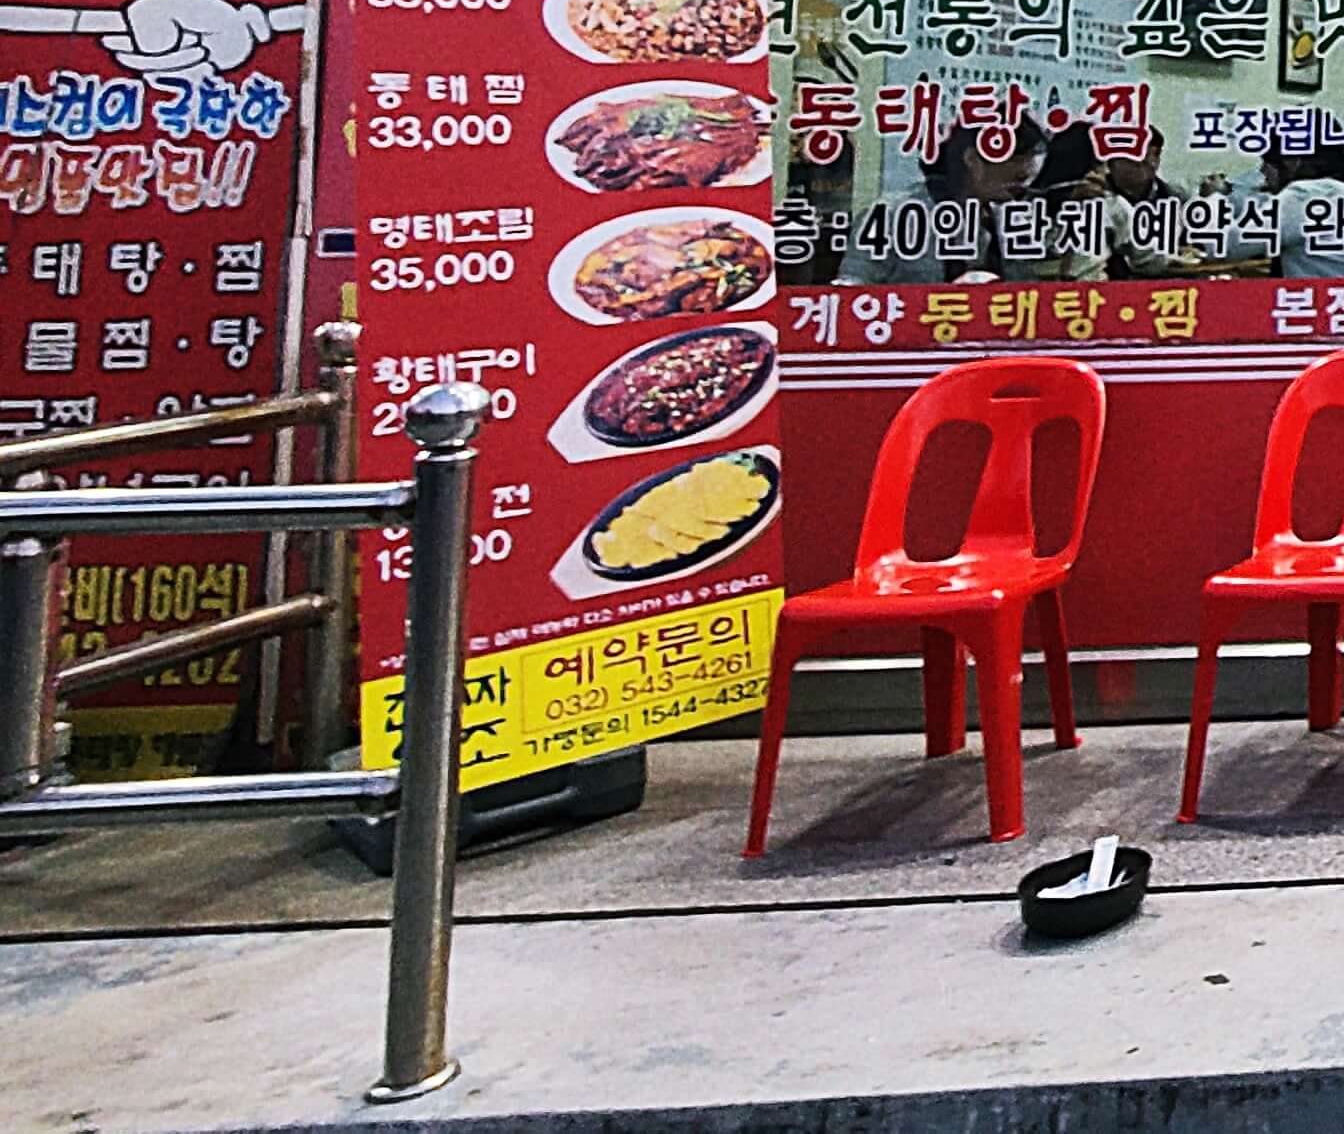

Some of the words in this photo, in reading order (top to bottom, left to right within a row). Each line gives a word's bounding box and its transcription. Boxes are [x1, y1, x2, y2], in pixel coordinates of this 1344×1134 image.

[368, 115, 512, 152] 33,000
[369, 206, 535, 250] 명태조림
[1000, 197, 1102, 261] 단체
[1131, 196, 1282, 260] 예약석
[369, 250, 516, 294] 35,000
[788, 289, 906, 347] 계양
[372, 342, 537, 396] 황태구이
[545, 609, 751, 685] 예약문의
[545, 685, 611, 721] 032)
[620, 650, 754, 704] 543-4261
[522, 716, 631, 756] 가맹문의
